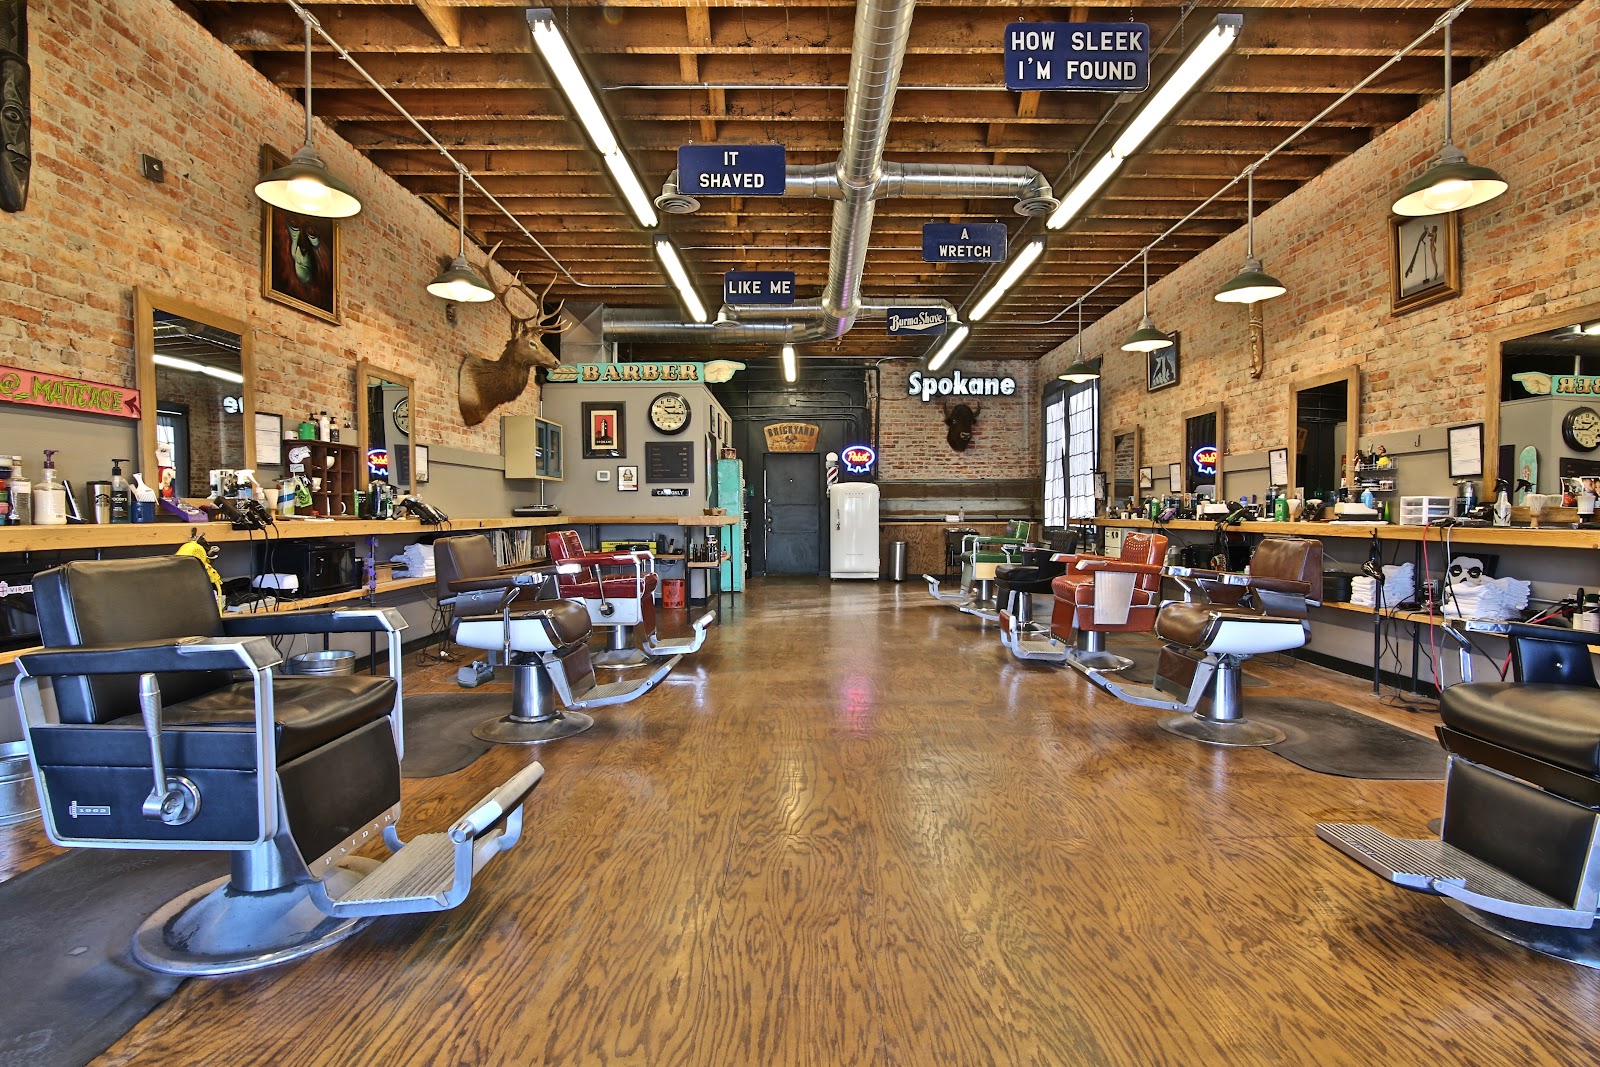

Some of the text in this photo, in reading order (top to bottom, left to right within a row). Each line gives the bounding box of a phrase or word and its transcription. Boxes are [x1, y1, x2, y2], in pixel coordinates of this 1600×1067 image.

[1011, 31, 1143, 51] HOW SLEEK
[1018, 57, 1137, 80] I'M FOUND
[724, 151, 739, 166] IT
[699, 173, 765, 188] SHAVED
[960, 227, 970, 240] A
[939, 244, 991, 258] WRETCH
[728, 280, 791, 294] LIKE ME
[889, 311, 944, 332] Burma-Shave
[581, 364, 699, 382] BARBER
[908, 370, 1016, 402] Spokane
[767, 425, 815, 438] BRICKYARD
[847, 450, 871, 463] Pabst
[9, 585, 32, 593] VIRGI
[325, 814, 391, 865] PAIDAR
